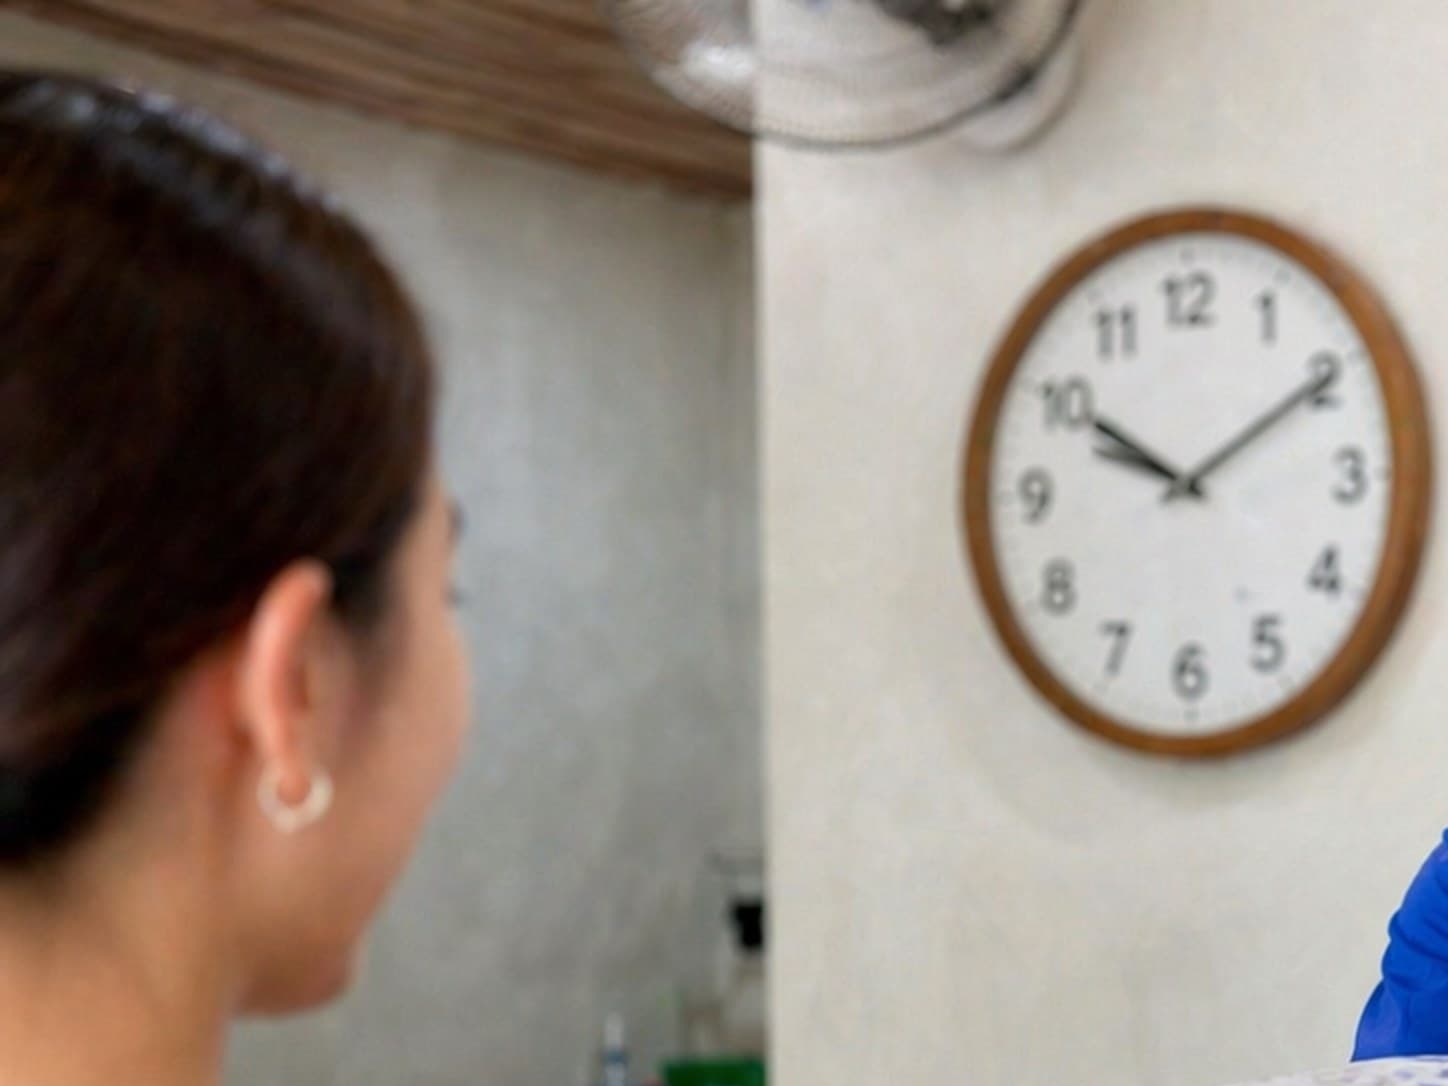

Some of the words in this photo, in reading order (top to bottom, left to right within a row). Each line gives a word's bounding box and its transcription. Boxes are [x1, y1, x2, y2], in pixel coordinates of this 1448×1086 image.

[1161, 271, 1216, 327] 12
[1255, 290, 1277, 344] 1
[1093, 305, 1136, 359] 11
[1039, 376, 1093, 430] 10
[1306, 350, 1342, 411] 2
[1016, 467, 1054, 525] 9
[1331, 445, 1367, 505] 3
[1039, 558, 1076, 616] 8
[1307, 544, 1344, 596] 4
[1100, 620, 1133, 677] 7
[1250, 613, 1286, 674] 5
[1171, 643, 1209, 702] 6
